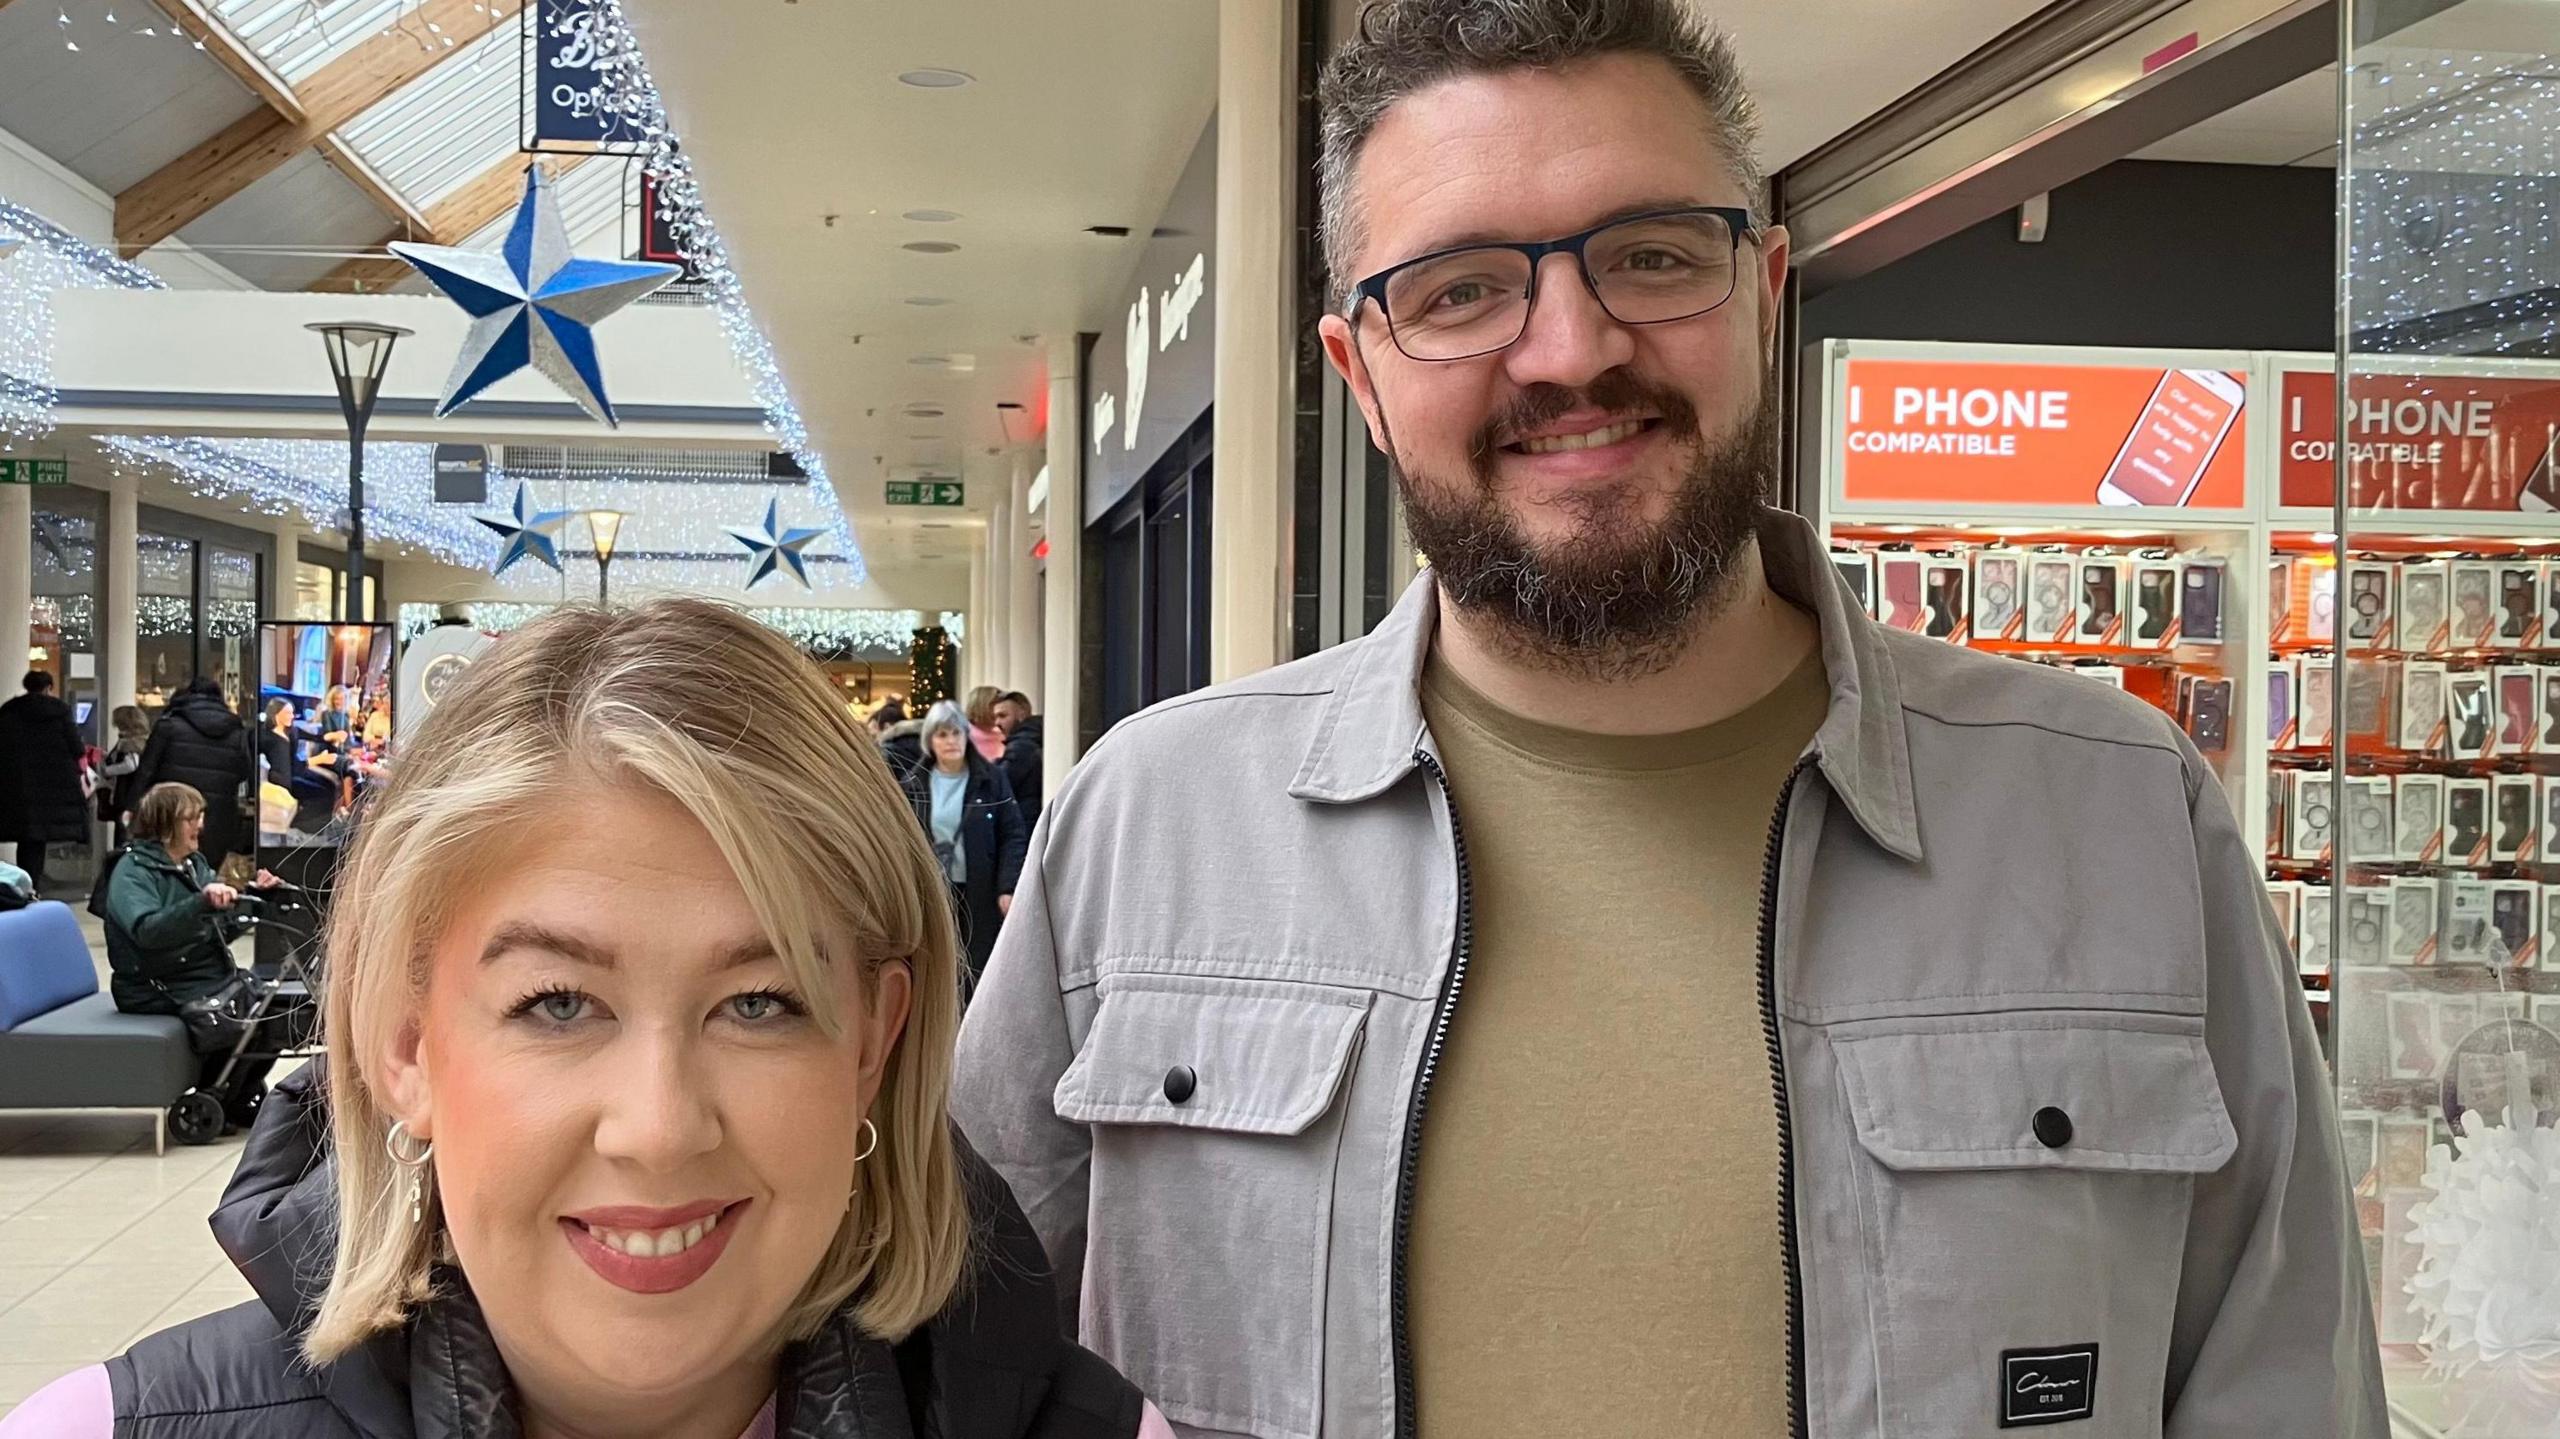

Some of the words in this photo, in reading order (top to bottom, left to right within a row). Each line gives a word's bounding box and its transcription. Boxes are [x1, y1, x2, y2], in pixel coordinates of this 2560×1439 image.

[1850, 386, 1860, 423] I
[1894, 387, 2069, 428] PHONE
[2292, 396, 2302, 432] I
[1848, 431, 2016, 455] COMPATIBLE
[38, 461, 65, 472] FIRE
[38, 473, 64, 484] EXIT
[888, 483, 912, 493] FIRE
[888, 494, 912, 503] EXIT
